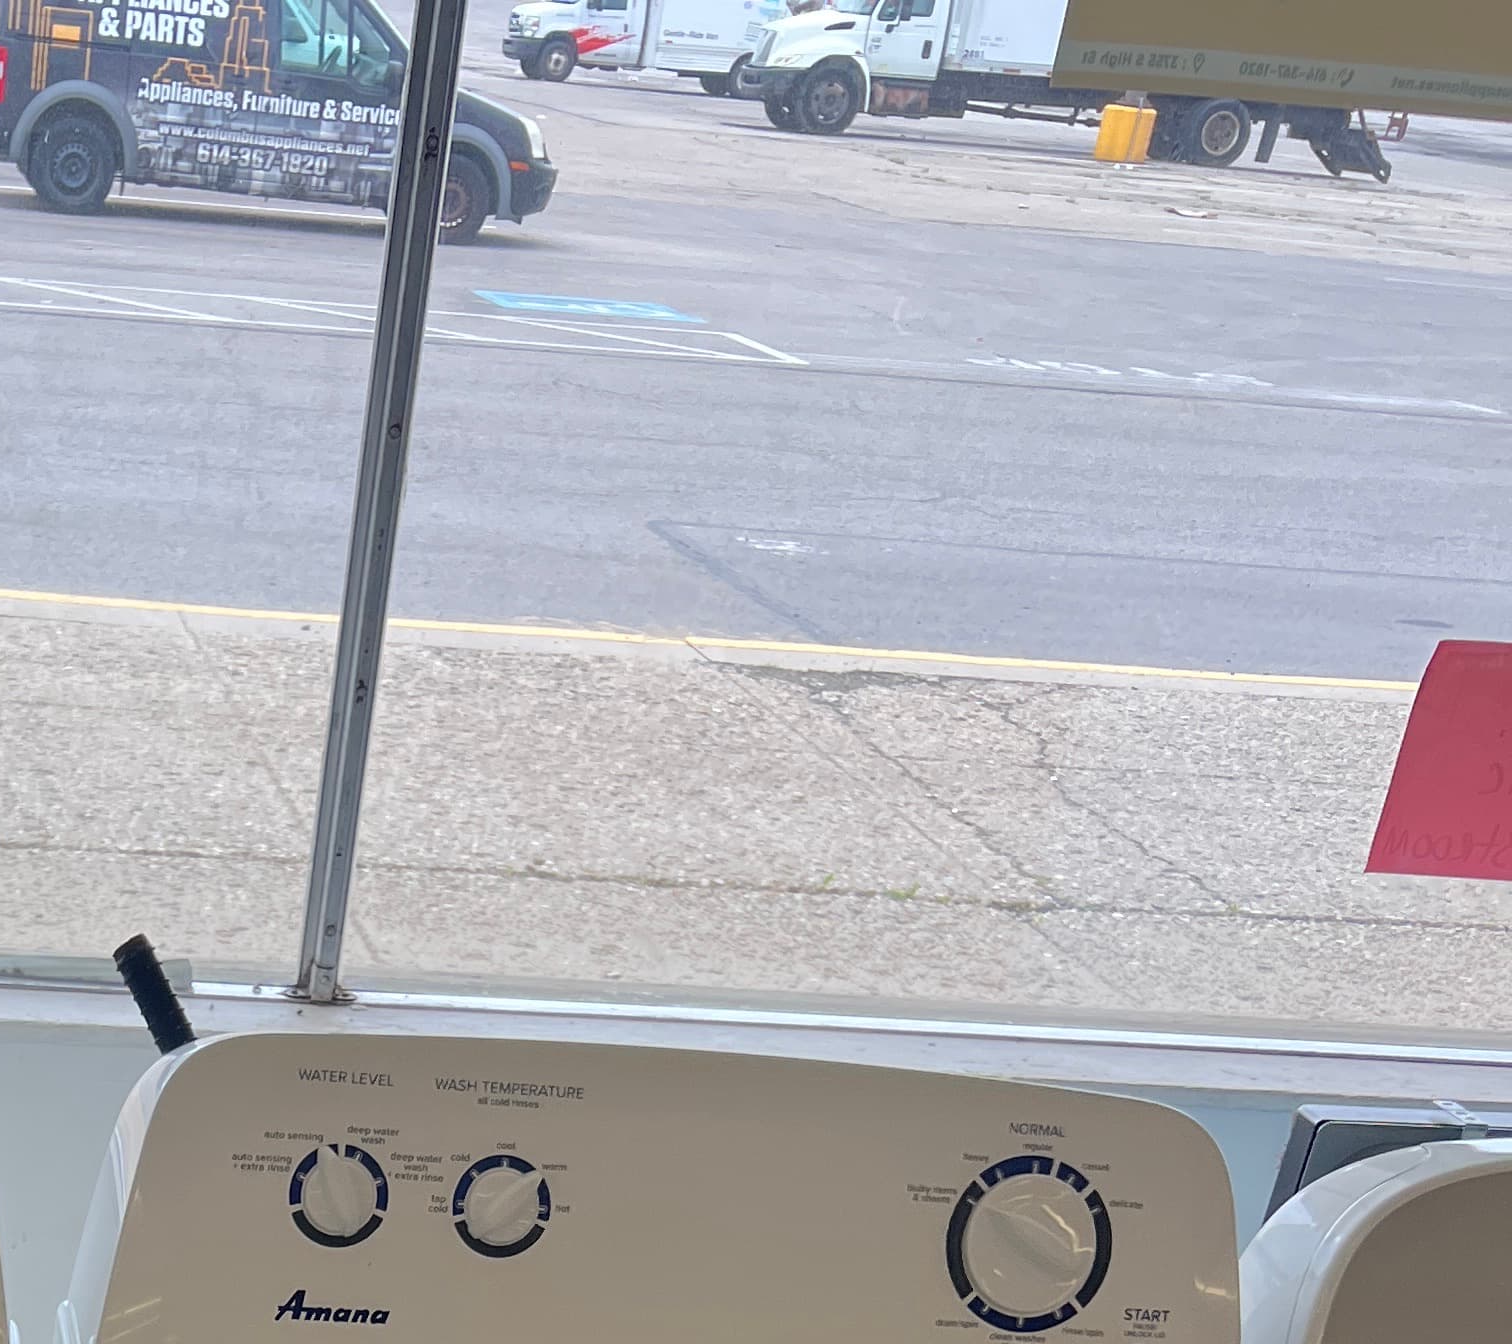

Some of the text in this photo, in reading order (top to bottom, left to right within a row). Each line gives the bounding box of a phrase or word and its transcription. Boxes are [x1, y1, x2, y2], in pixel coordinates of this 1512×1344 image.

[98, 7, 205, 47] & PARTS
[138, 78, 238, 112] Appliances,
[241, 90, 320, 120] Furniture
[323, 99, 337, 120] &
[158, 122, 371, 156] www.columbusappliances.net
[298, 1068, 395, 1088] WATER LEVEL
[435, 1077, 585, 1100] WASH TEMPERATURE
[264, 1130, 325, 1144] auto sensing
[347, 1125, 400, 1137] deep water
[1008, 1122, 1066, 1138] NORMAL
[361, 1135, 386, 1145] wash
[231, 1153, 293, 1166] auto sensing
[390, 1152, 443, 1165] deep water
[450, 1153, 471, 1162] cold
[403, 1162, 429, 1172] wash
[394, 1171, 419, 1182] extra
[421, 1172, 444, 1183] rinse
[428, 1204, 448, 1214] cold
[274, 1289, 391, 1325] Amana
[1123, 1308, 1170, 1322] START
